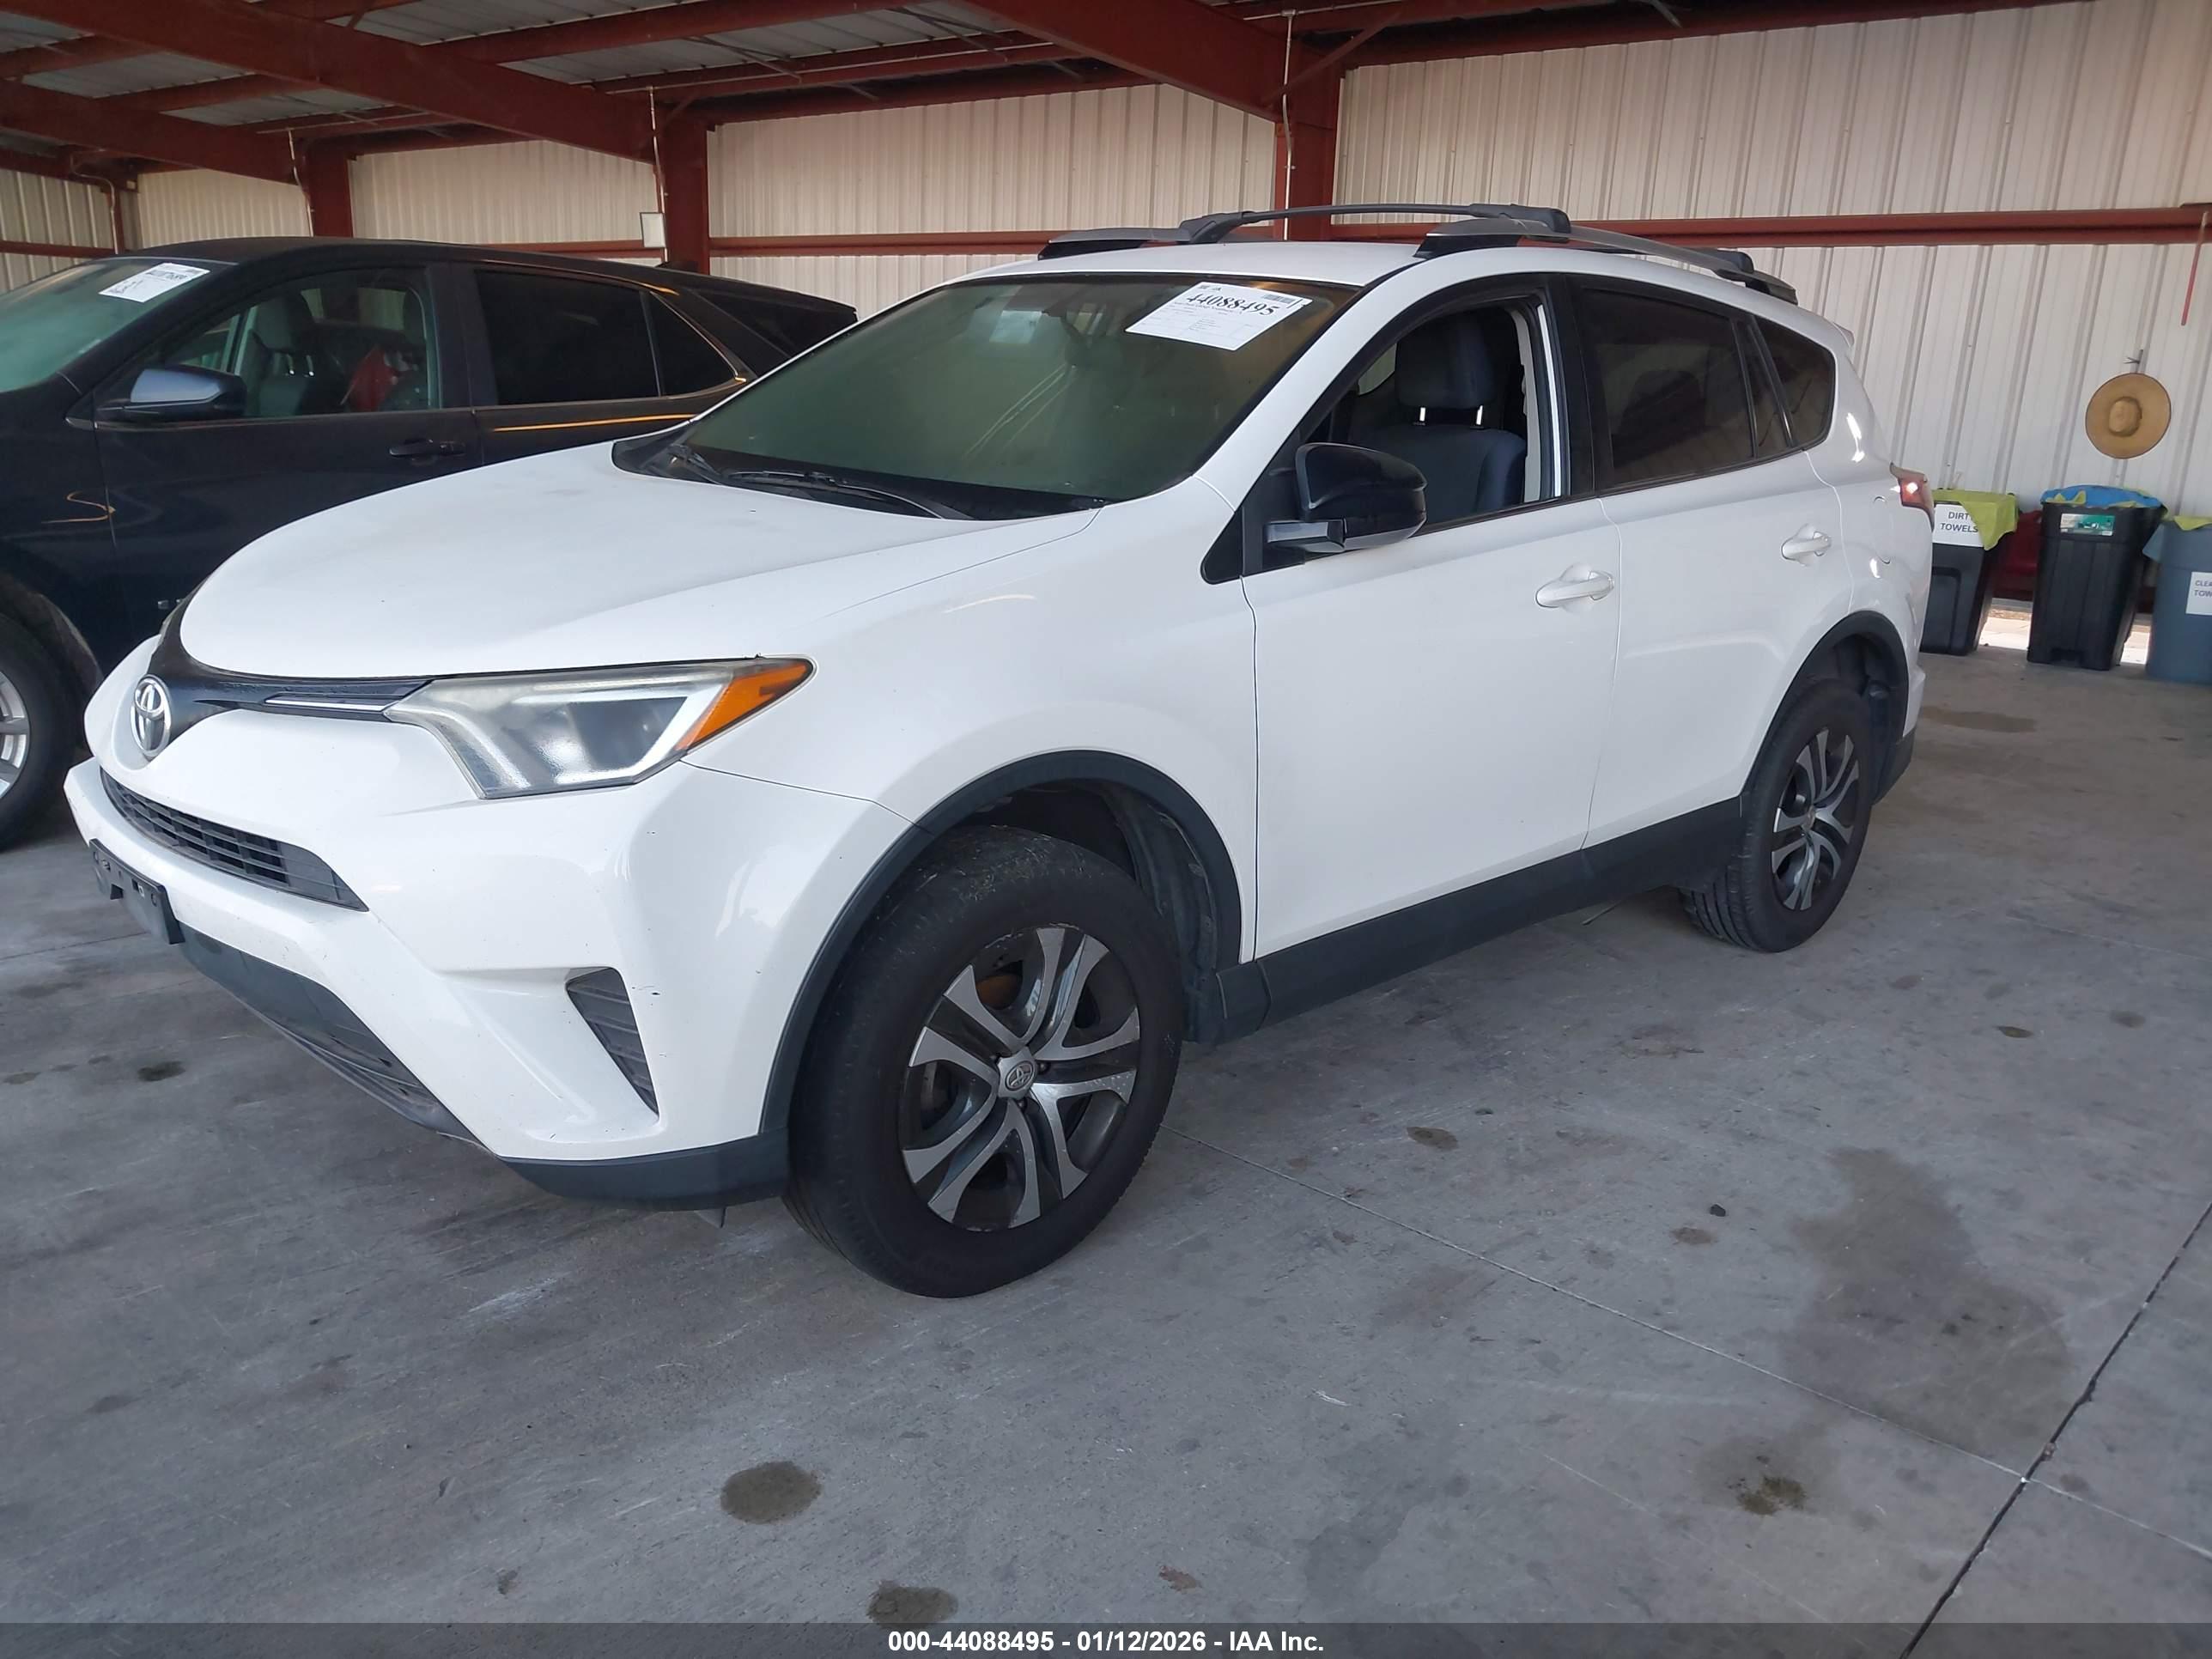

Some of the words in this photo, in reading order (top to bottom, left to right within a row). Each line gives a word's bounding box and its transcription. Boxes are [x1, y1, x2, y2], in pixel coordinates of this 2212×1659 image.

[1187, 293, 1280, 316] 44088495
[1948, 512, 1969, 520] DIRT
[1940, 522, 1978, 533] TOWELS
